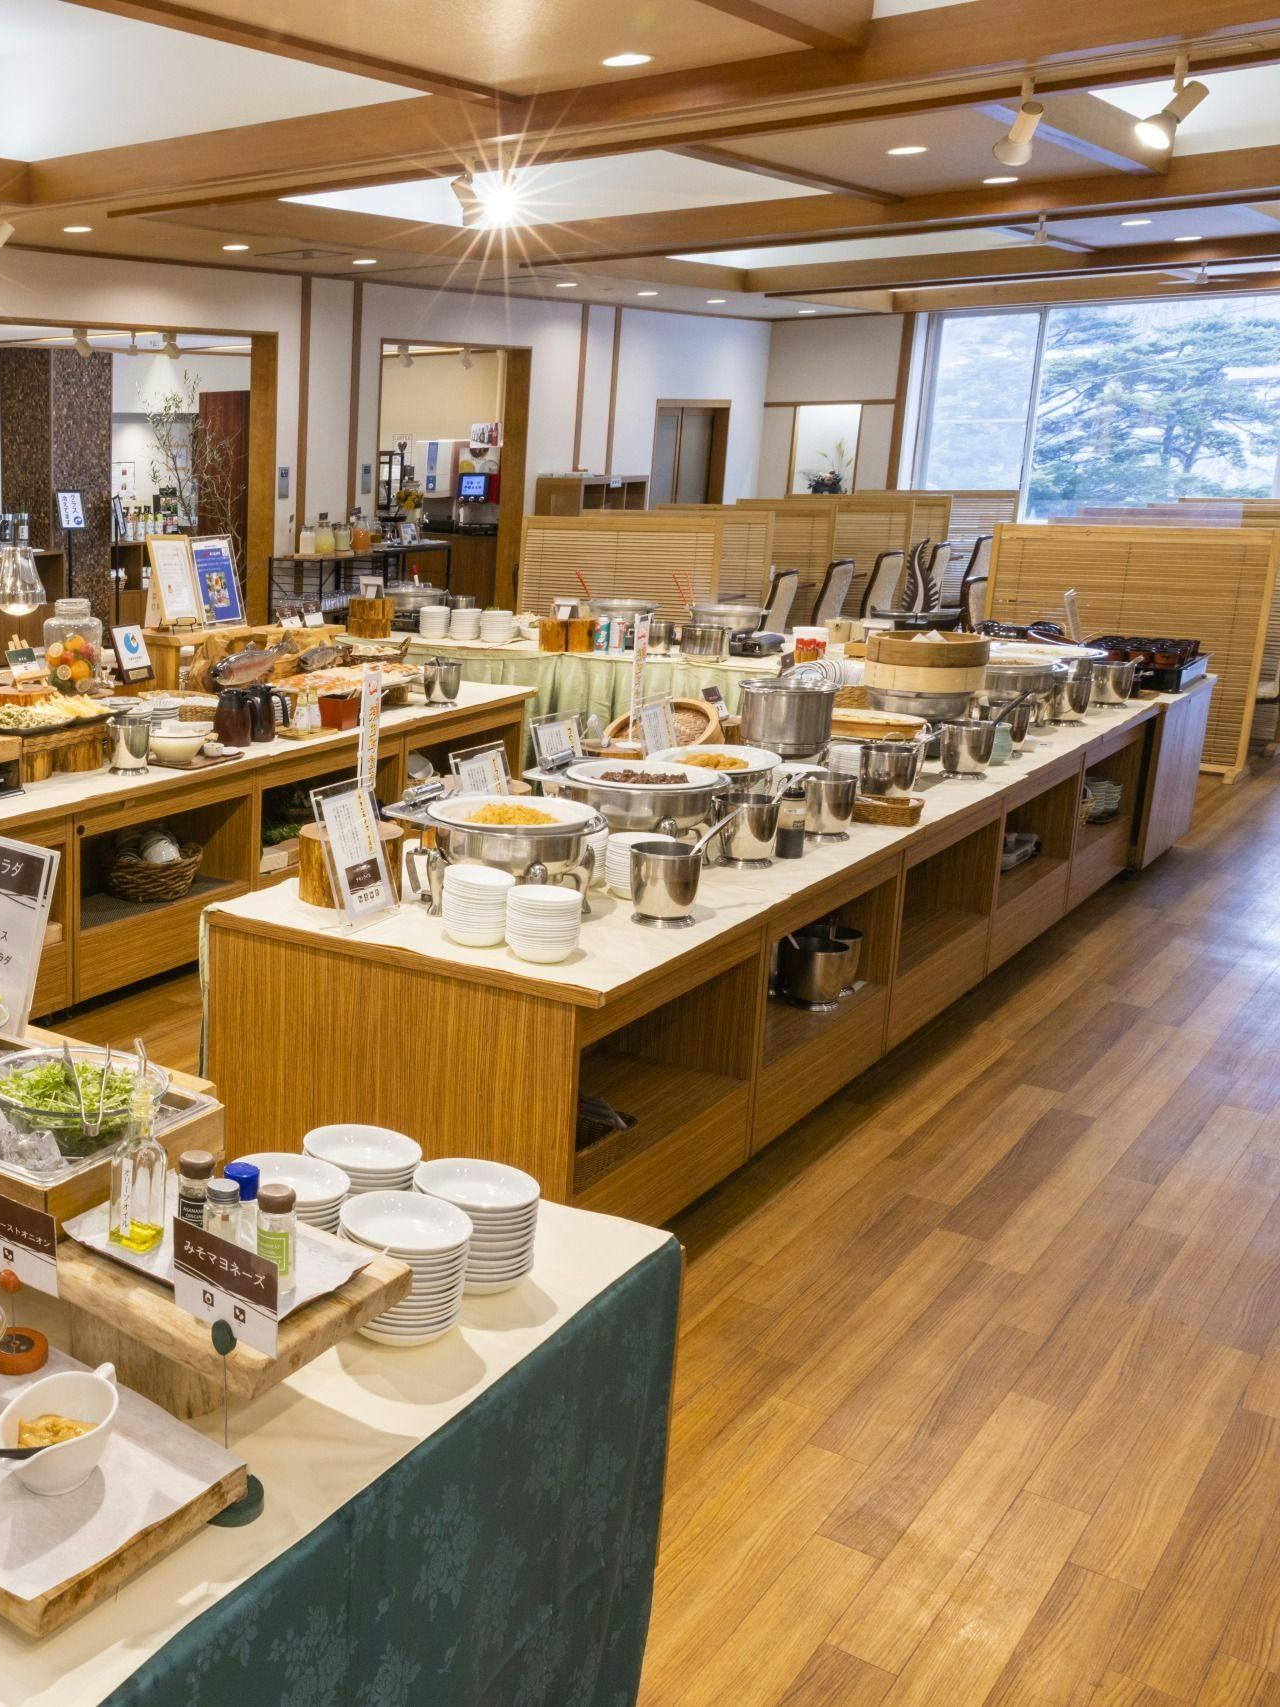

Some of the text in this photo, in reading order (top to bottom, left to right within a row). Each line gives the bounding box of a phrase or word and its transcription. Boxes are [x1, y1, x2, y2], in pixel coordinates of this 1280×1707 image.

[184, 1240, 266, 1289] みそマヨネーズ
